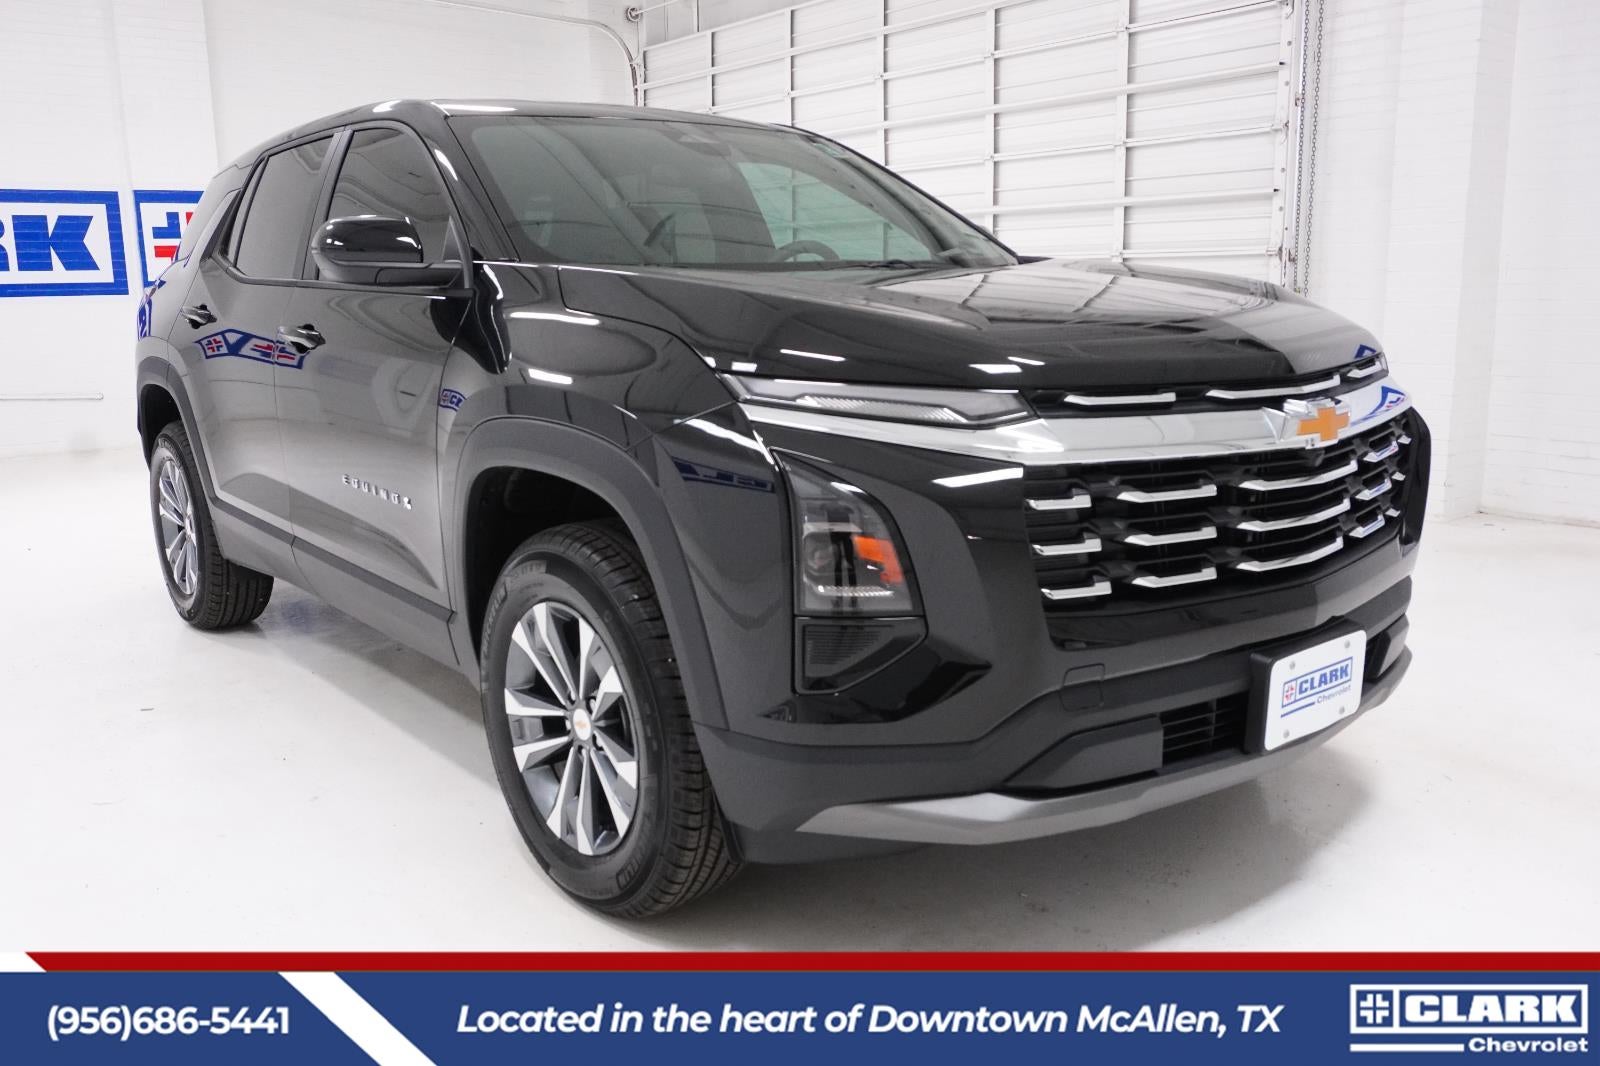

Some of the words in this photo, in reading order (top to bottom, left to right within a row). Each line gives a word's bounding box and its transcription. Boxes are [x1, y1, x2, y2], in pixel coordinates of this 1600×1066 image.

[342, 473, 413, 510] EQUINOX
[1298, 663, 1349, 695] CLARK
[1316, 684, 1351, 704] Chevrolet
